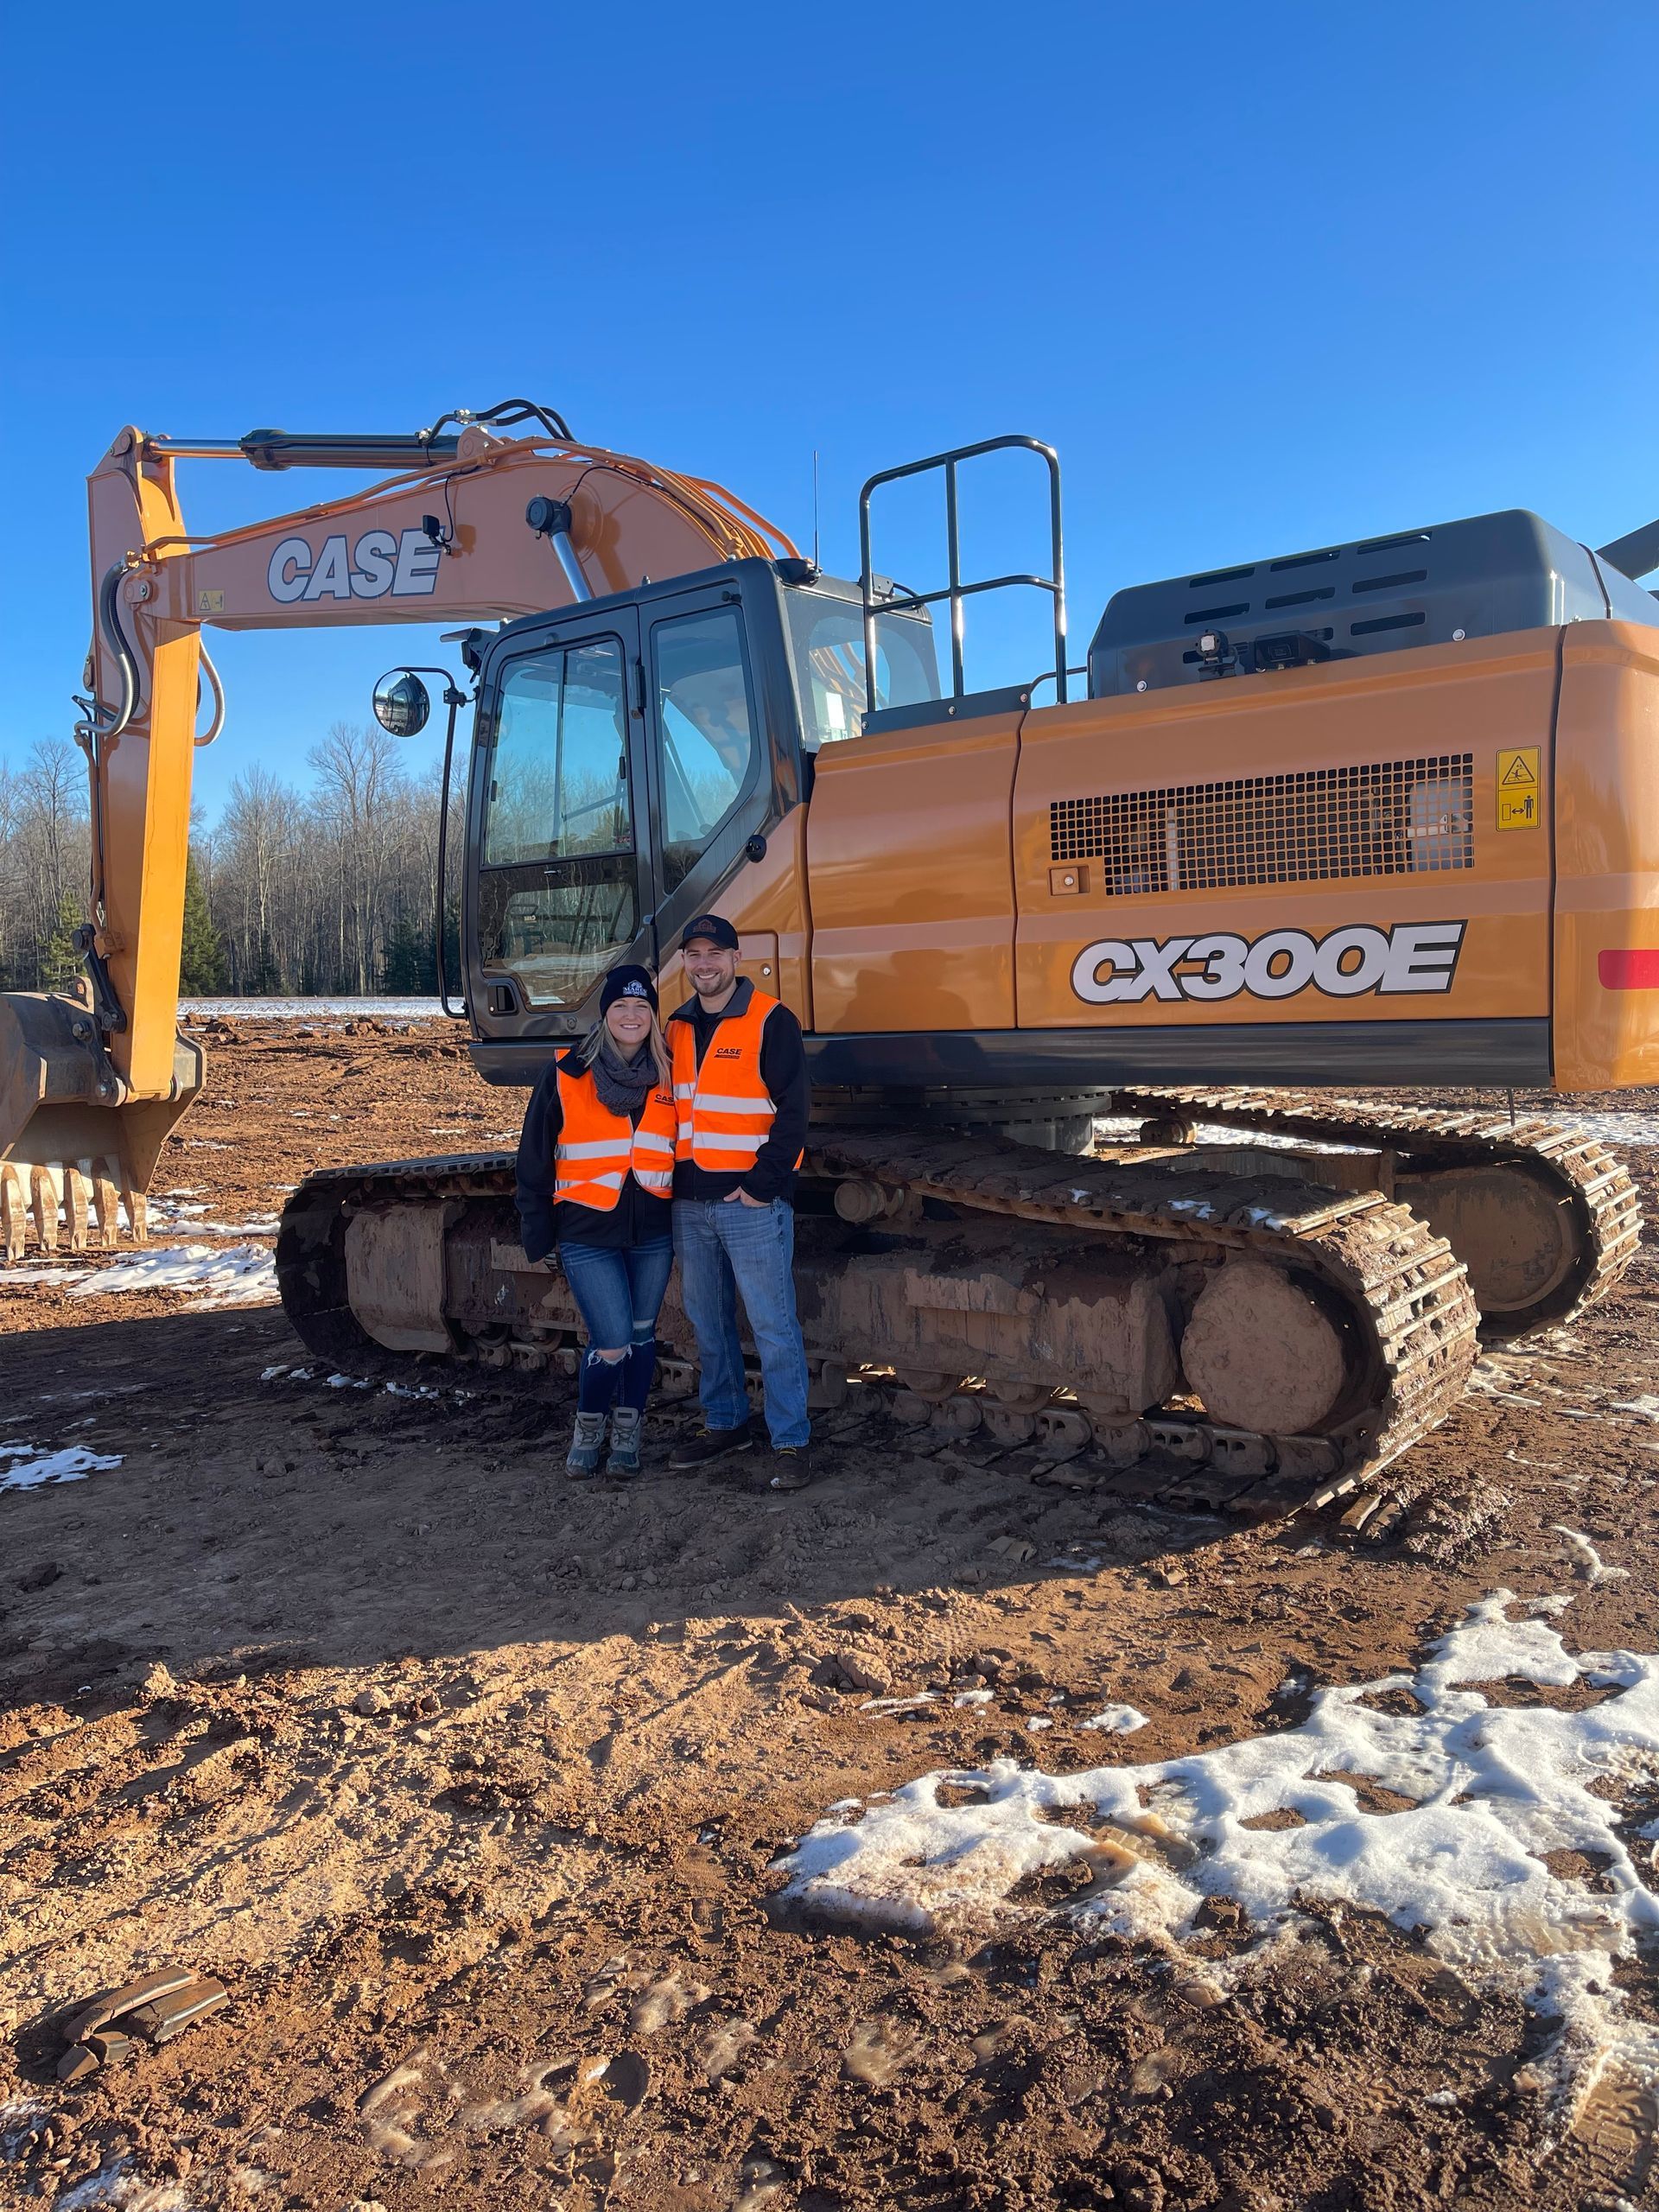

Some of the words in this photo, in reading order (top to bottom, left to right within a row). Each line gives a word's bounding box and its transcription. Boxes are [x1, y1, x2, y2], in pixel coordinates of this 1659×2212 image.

[268, 525, 446, 603] CASE
[1070, 919, 1468, 1006] CX300E
[655, 1094, 674, 1103] CAS
